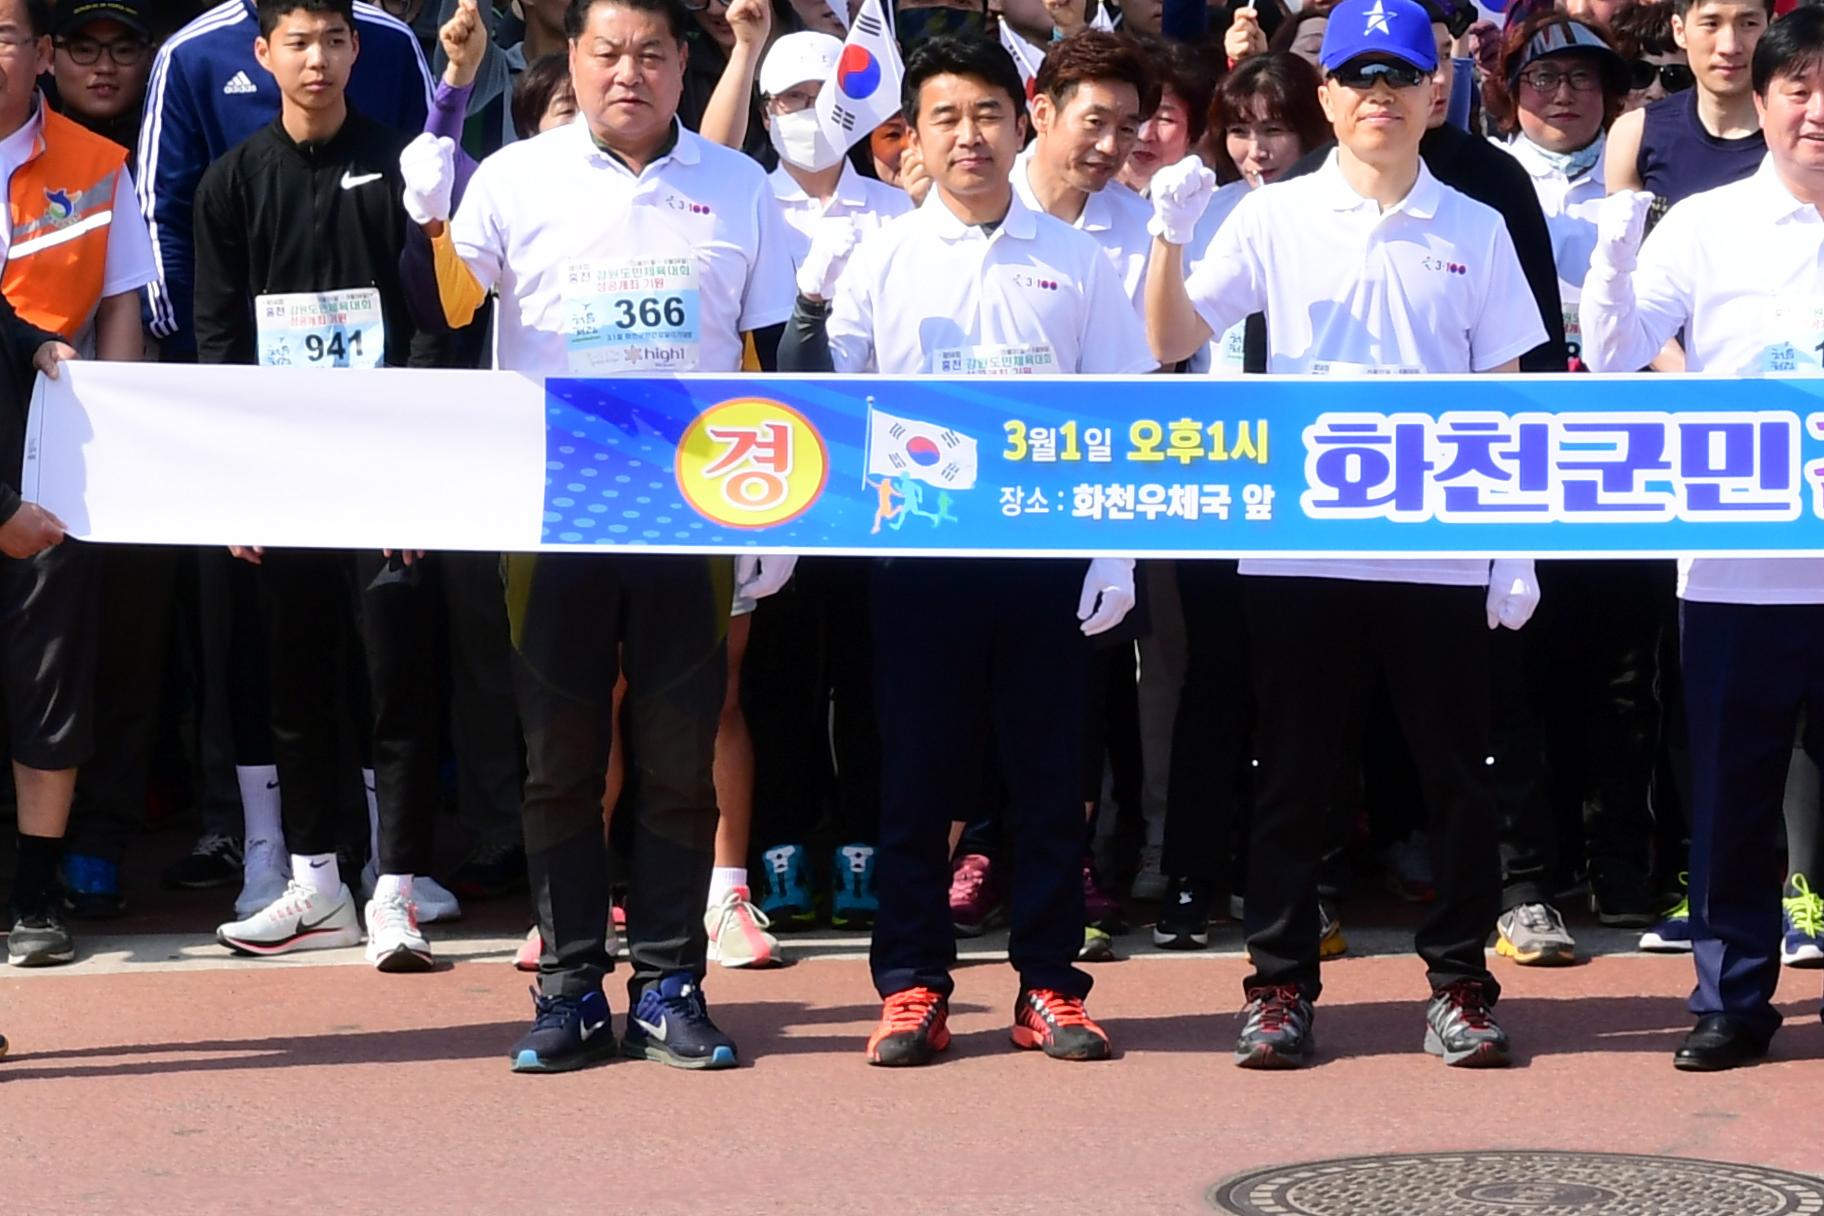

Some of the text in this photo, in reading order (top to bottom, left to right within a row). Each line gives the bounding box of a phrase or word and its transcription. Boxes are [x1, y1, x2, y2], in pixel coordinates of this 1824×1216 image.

[614, 297, 685, 329] 366
[305, 328, 363, 363] 941
[1002, 417, 1270, 465] 3월1일 오후1시
[704, 422, 792, 510] 경
[999, 486, 1050, 516] 장소
[1071, 483, 1229, 522] 화천우체국
[1242, 481, 1273, 522] 앞
